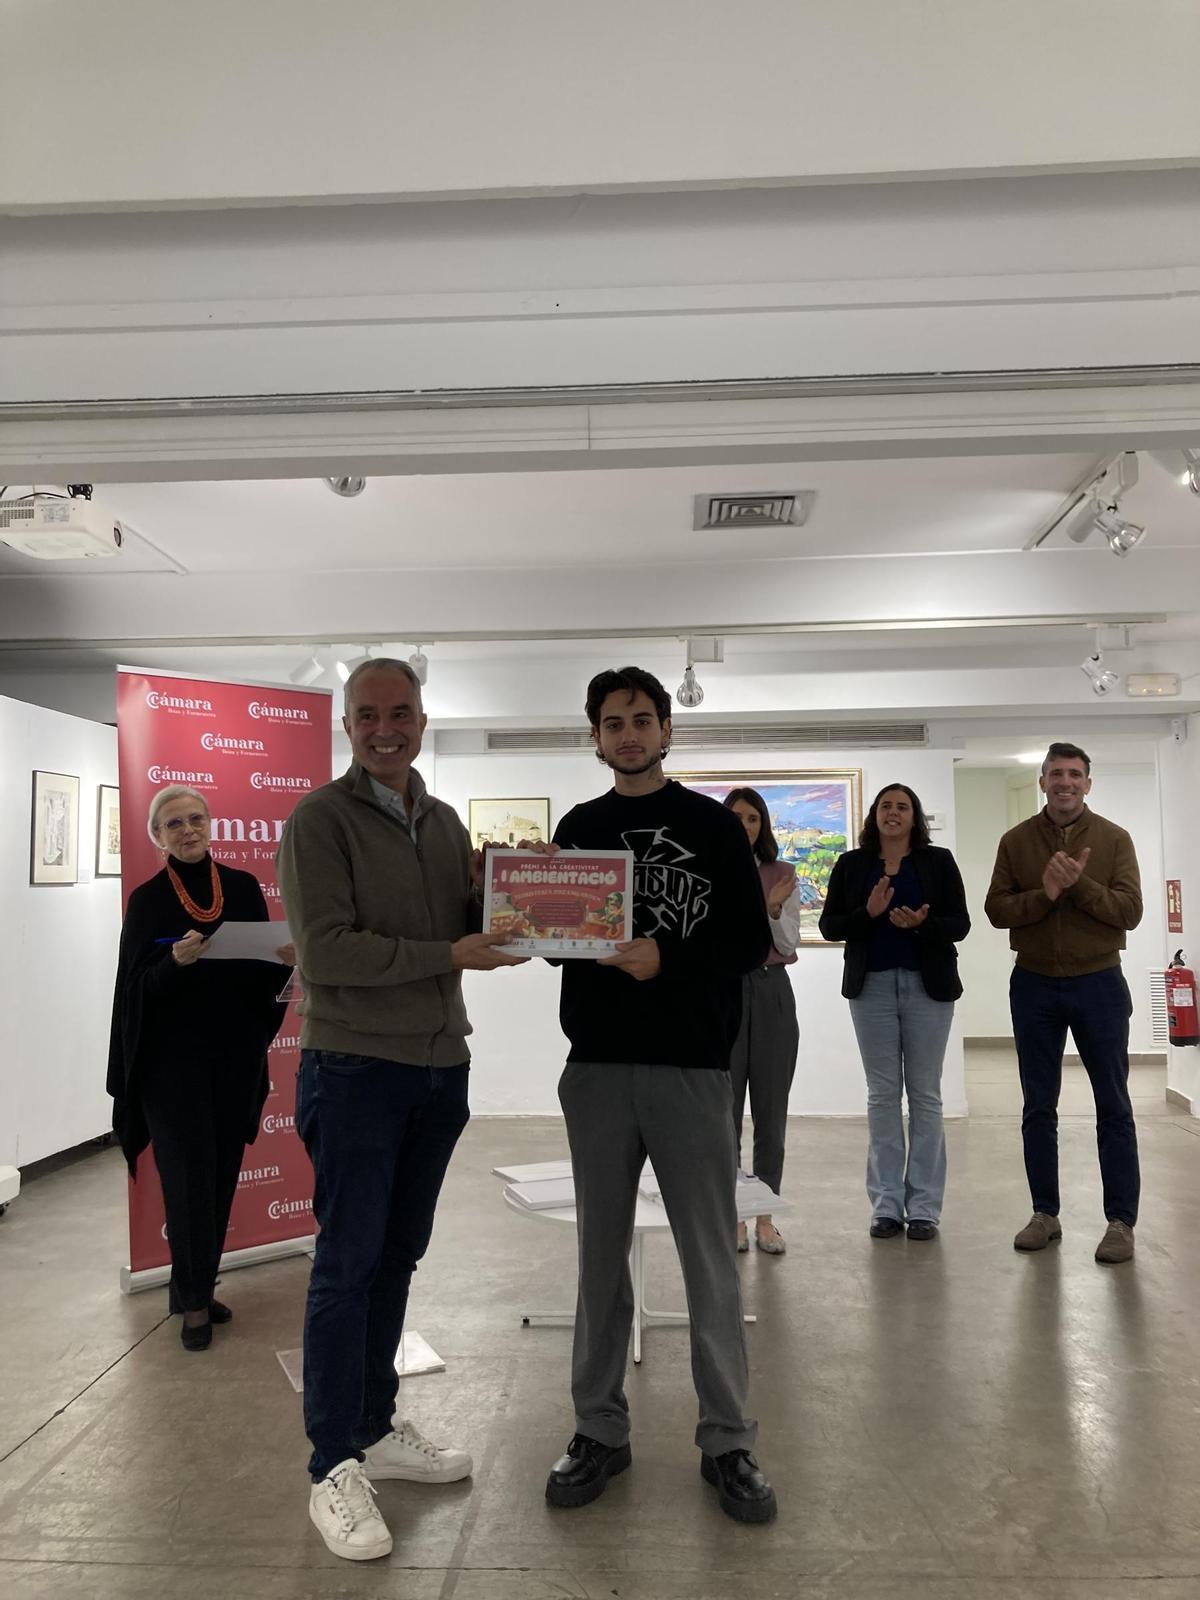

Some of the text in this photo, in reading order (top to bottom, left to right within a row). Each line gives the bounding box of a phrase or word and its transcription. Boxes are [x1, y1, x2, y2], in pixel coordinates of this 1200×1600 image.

[209, 848, 236, 860] biza
[241, 851, 248, 863] y
[510, 870, 617, 886] AMBIENTACIÓ
[239, 1166, 280, 1182] mara
[268, 1198, 313, 1219] Cáma
